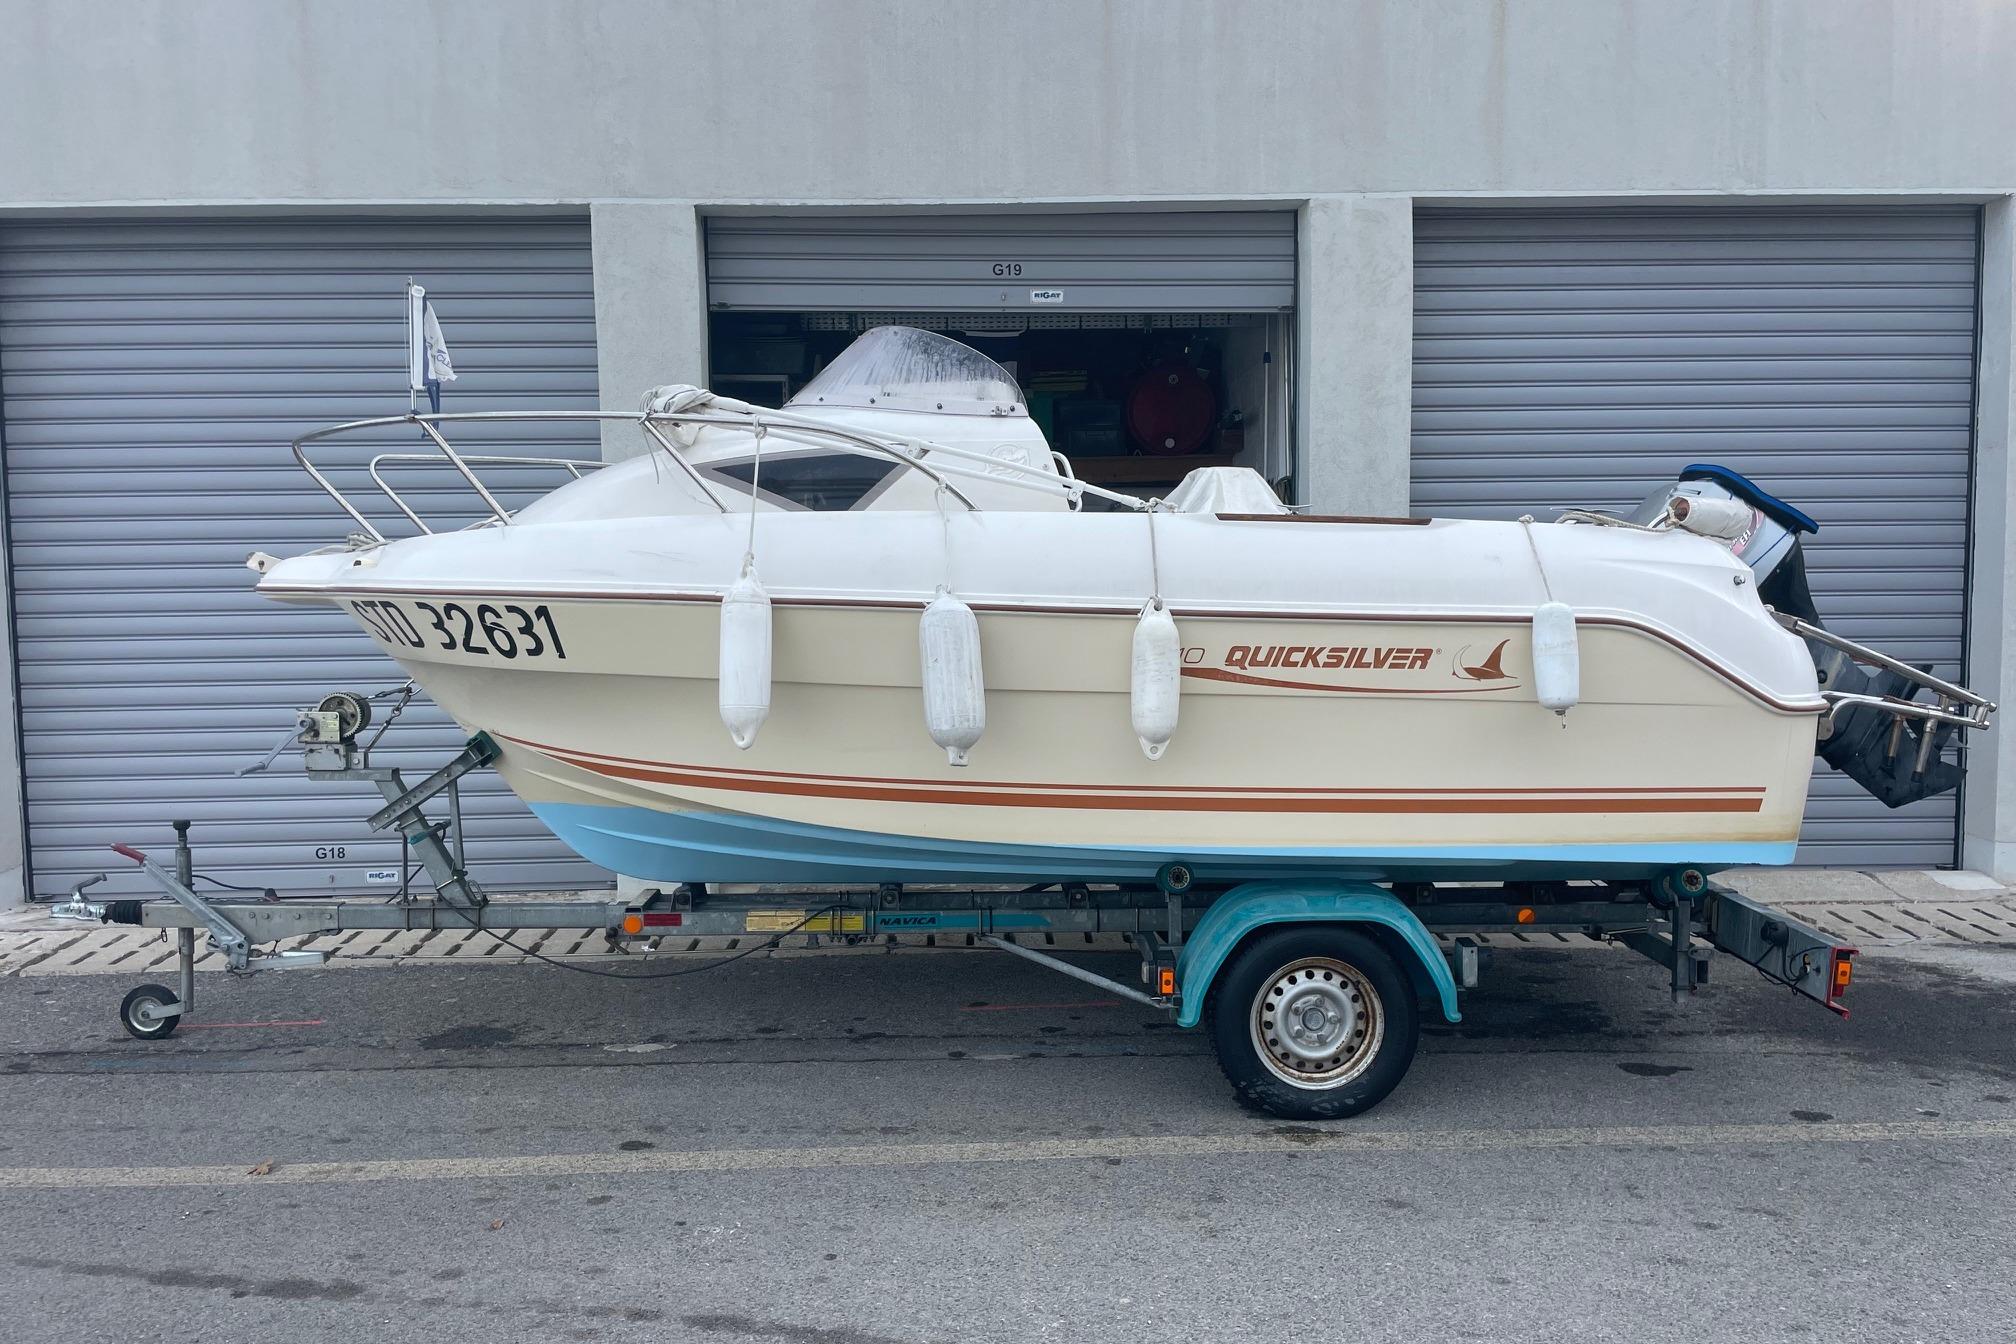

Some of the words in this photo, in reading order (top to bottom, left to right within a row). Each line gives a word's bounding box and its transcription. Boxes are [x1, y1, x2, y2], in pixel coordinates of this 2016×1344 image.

[992, 263, 1023, 276] G19
[1033, 291, 1062, 299] RIGAT
[351, 600, 425, 649] STD
[415, 602, 567, 660] 32631
[1224, 645, 1434, 671] QUICKSILVER
[315, 847, 346, 859] G18
[368, 872, 397, 880] RIGAT
[880, 916, 938, 926] NAVICA
